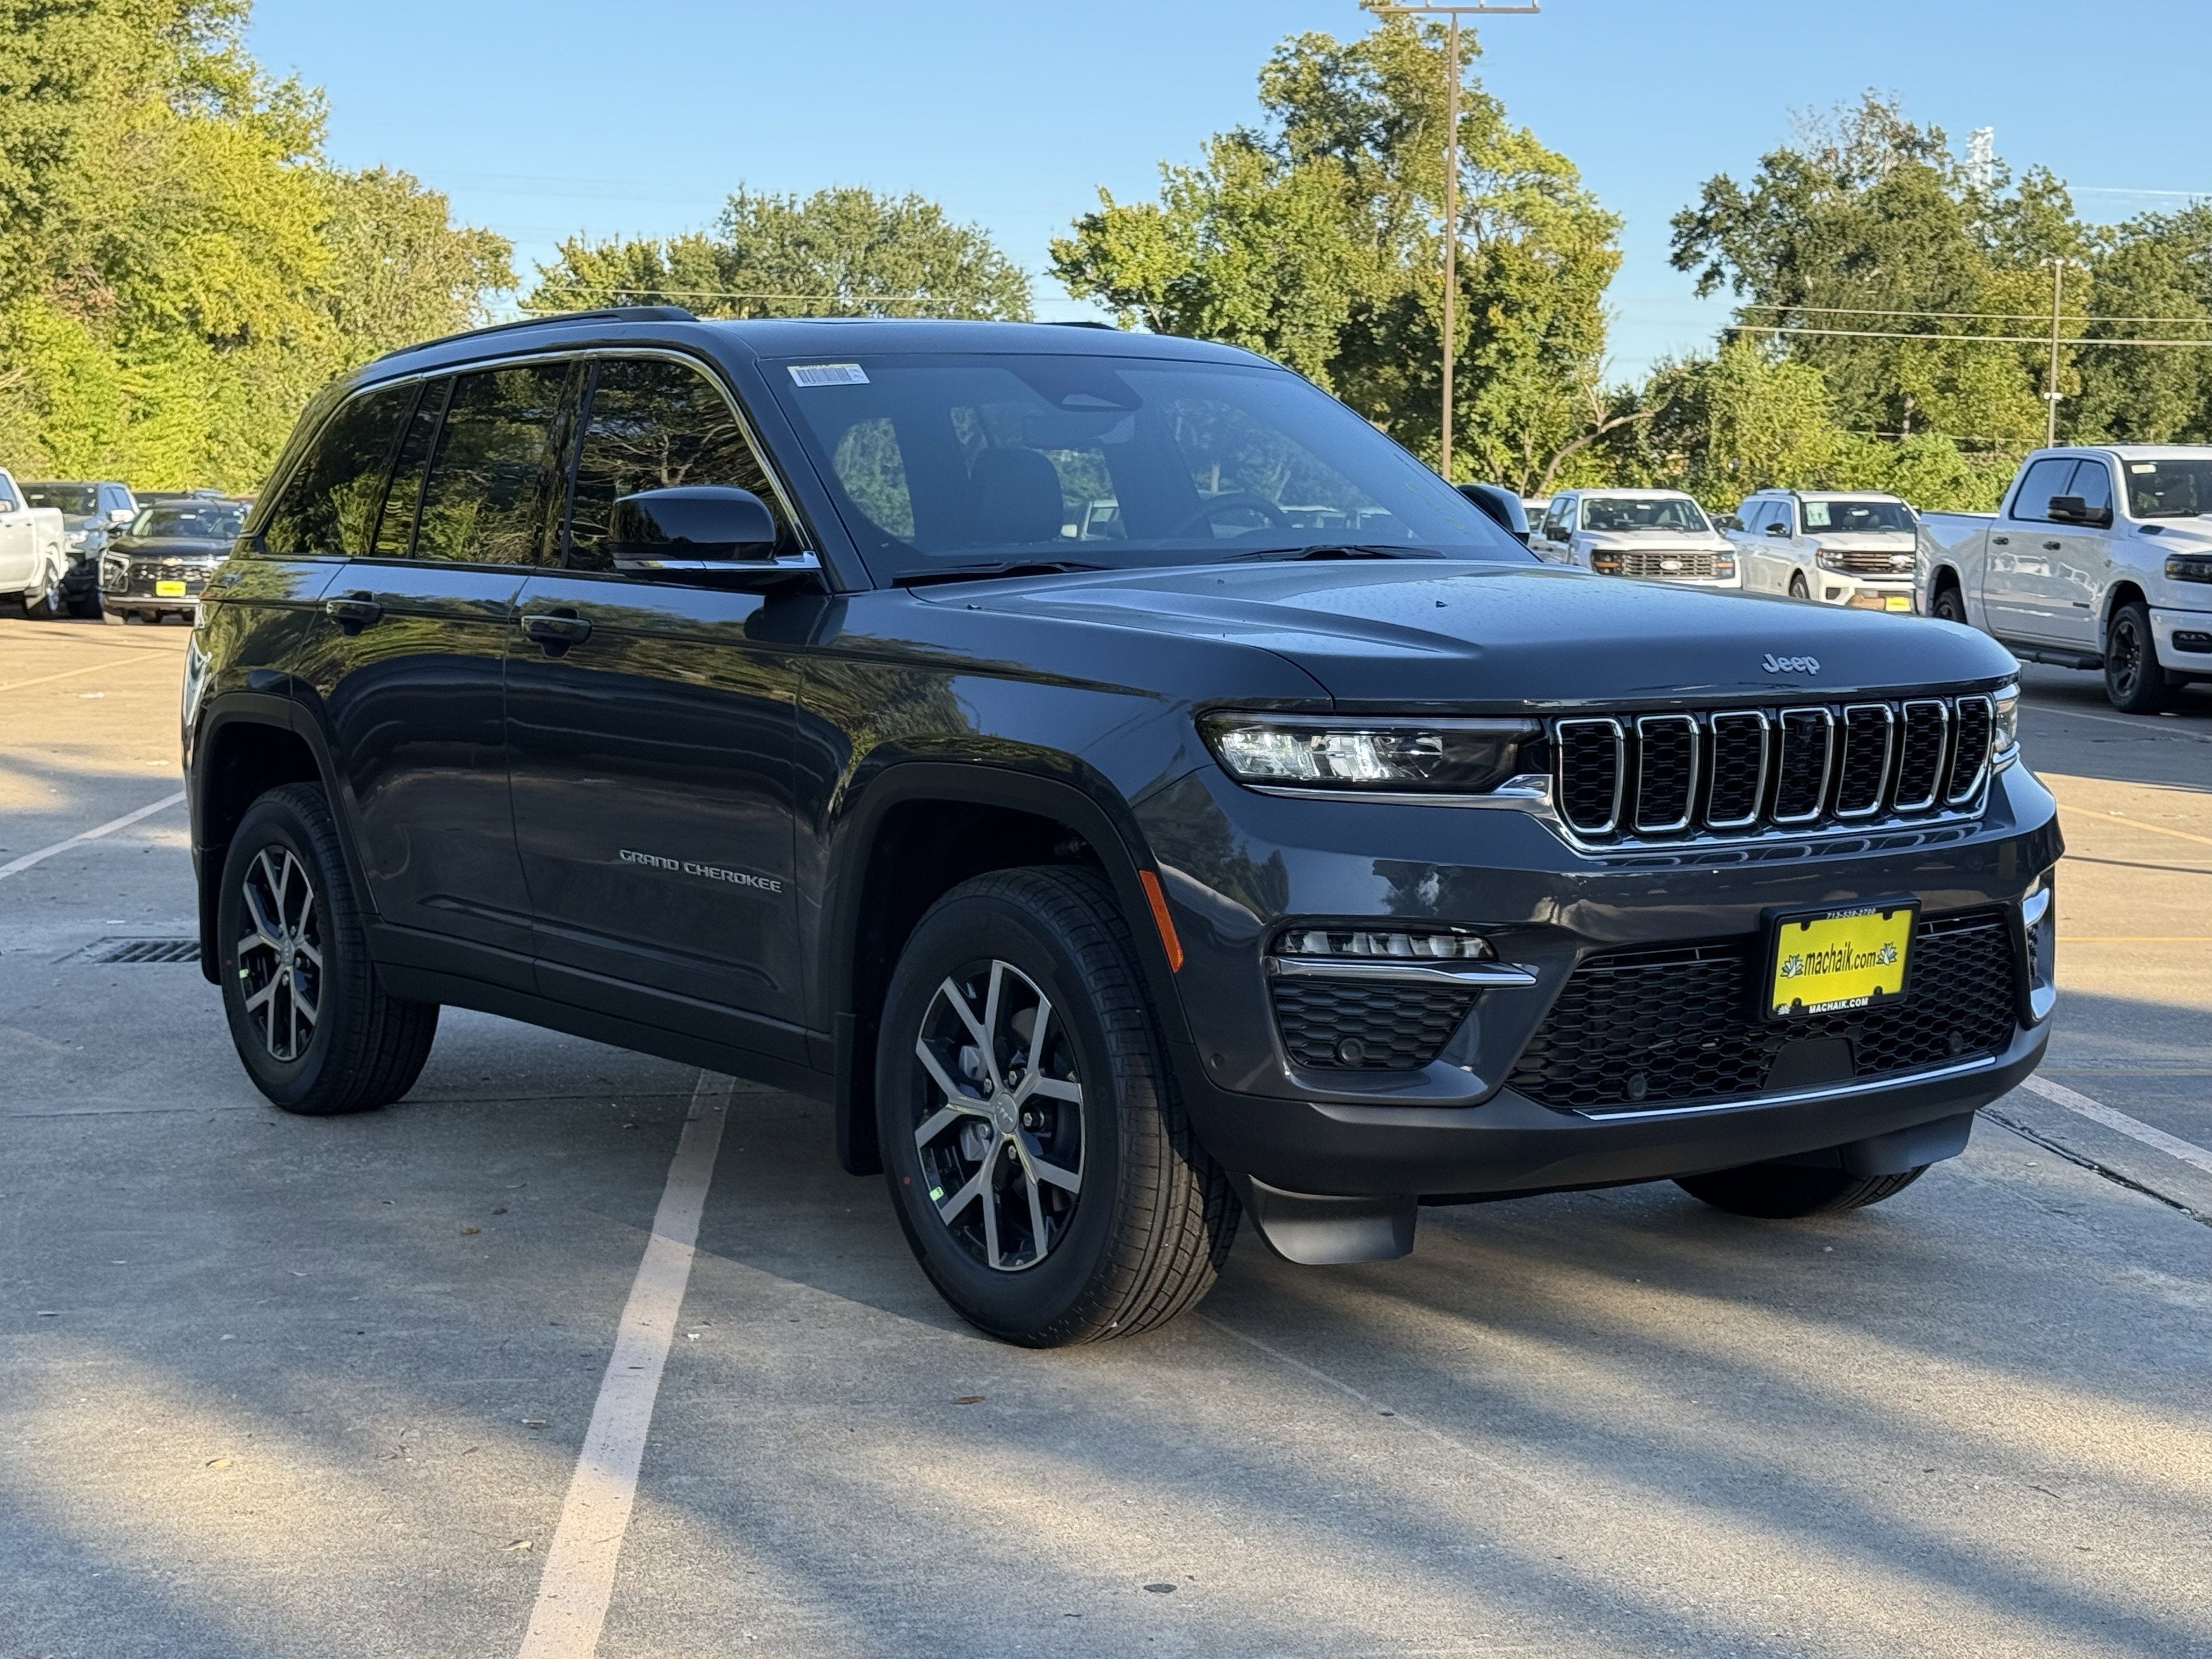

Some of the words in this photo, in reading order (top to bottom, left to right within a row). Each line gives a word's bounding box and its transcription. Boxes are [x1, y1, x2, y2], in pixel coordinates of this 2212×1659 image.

[1761, 653, 1820, 675] Jeep
[619, 849, 679, 871] GRAND
[684, 862, 782, 893] CHEROKEE
[1804, 940, 1876, 976] machaik.com
[1808, 997, 1869, 1014] MACHAIK.COM
